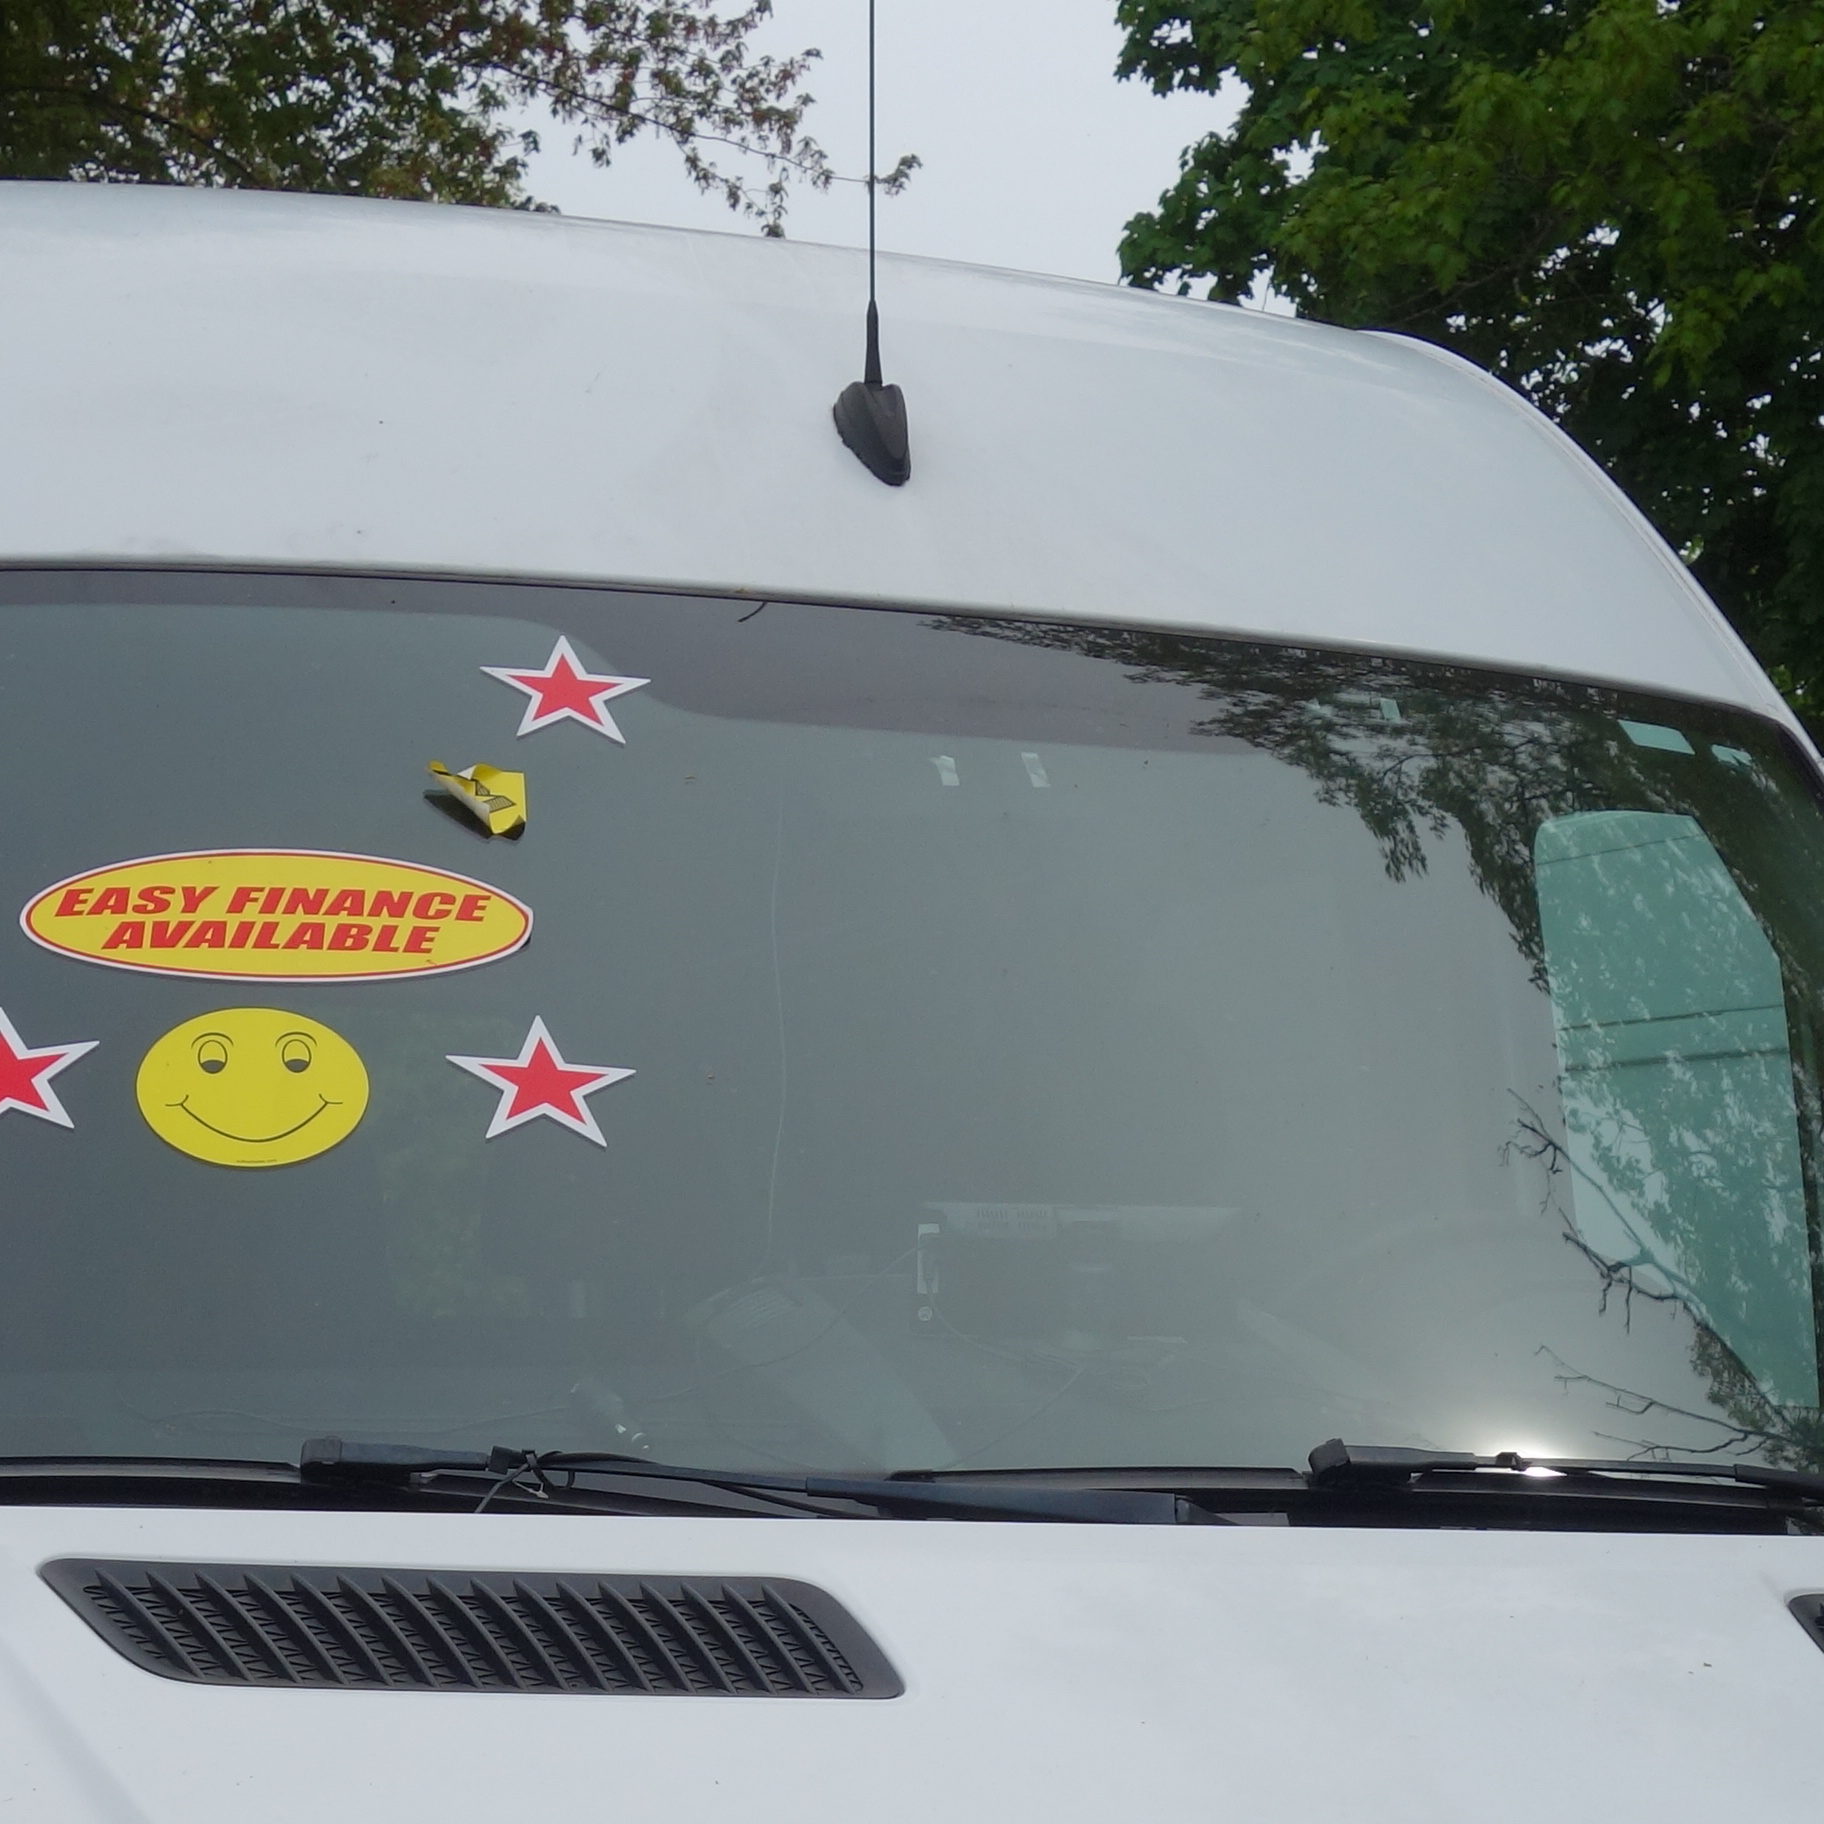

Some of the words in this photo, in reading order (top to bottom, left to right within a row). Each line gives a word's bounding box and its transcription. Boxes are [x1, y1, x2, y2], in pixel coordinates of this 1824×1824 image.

[54, 886, 220, 917] EASY
[226, 886, 492, 922] FINANCE
[101, 920, 441, 954] AVAILABLE
